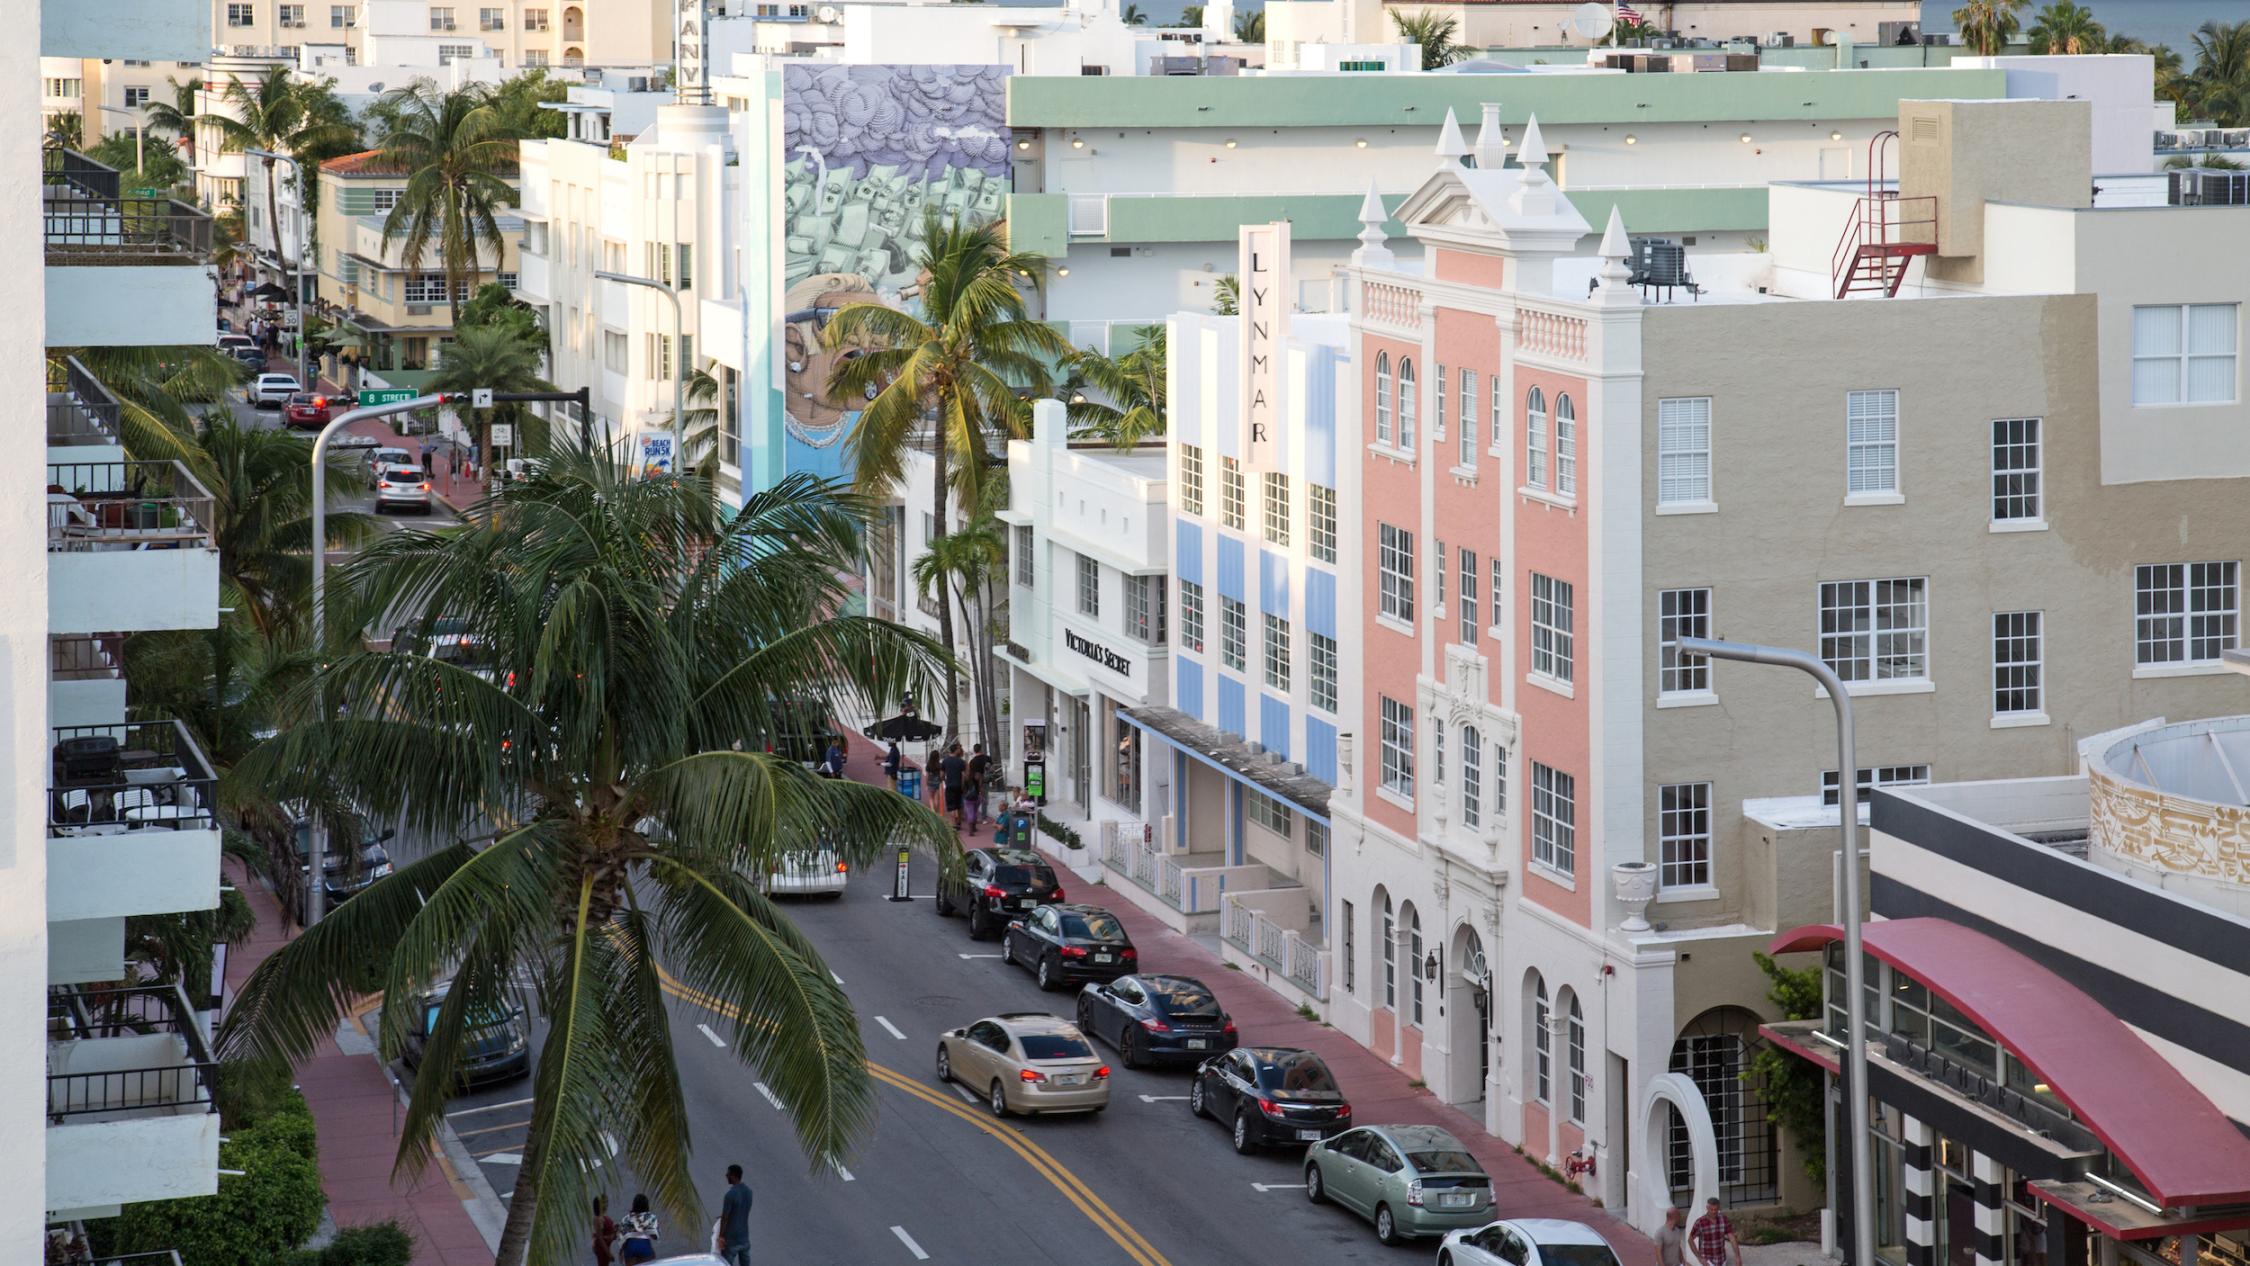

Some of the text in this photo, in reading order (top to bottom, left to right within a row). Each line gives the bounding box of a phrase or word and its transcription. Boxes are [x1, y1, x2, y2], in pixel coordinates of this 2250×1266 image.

[1252, 252, 1268, 443] LYNMAR
[369, 394, 411, 403] 8 STREET
[1065, 627, 1103, 664] VICTORIA'S
[1104, 647, 1131, 677] SECRET
[1906, 1040, 2026, 1118] SEPHORA
